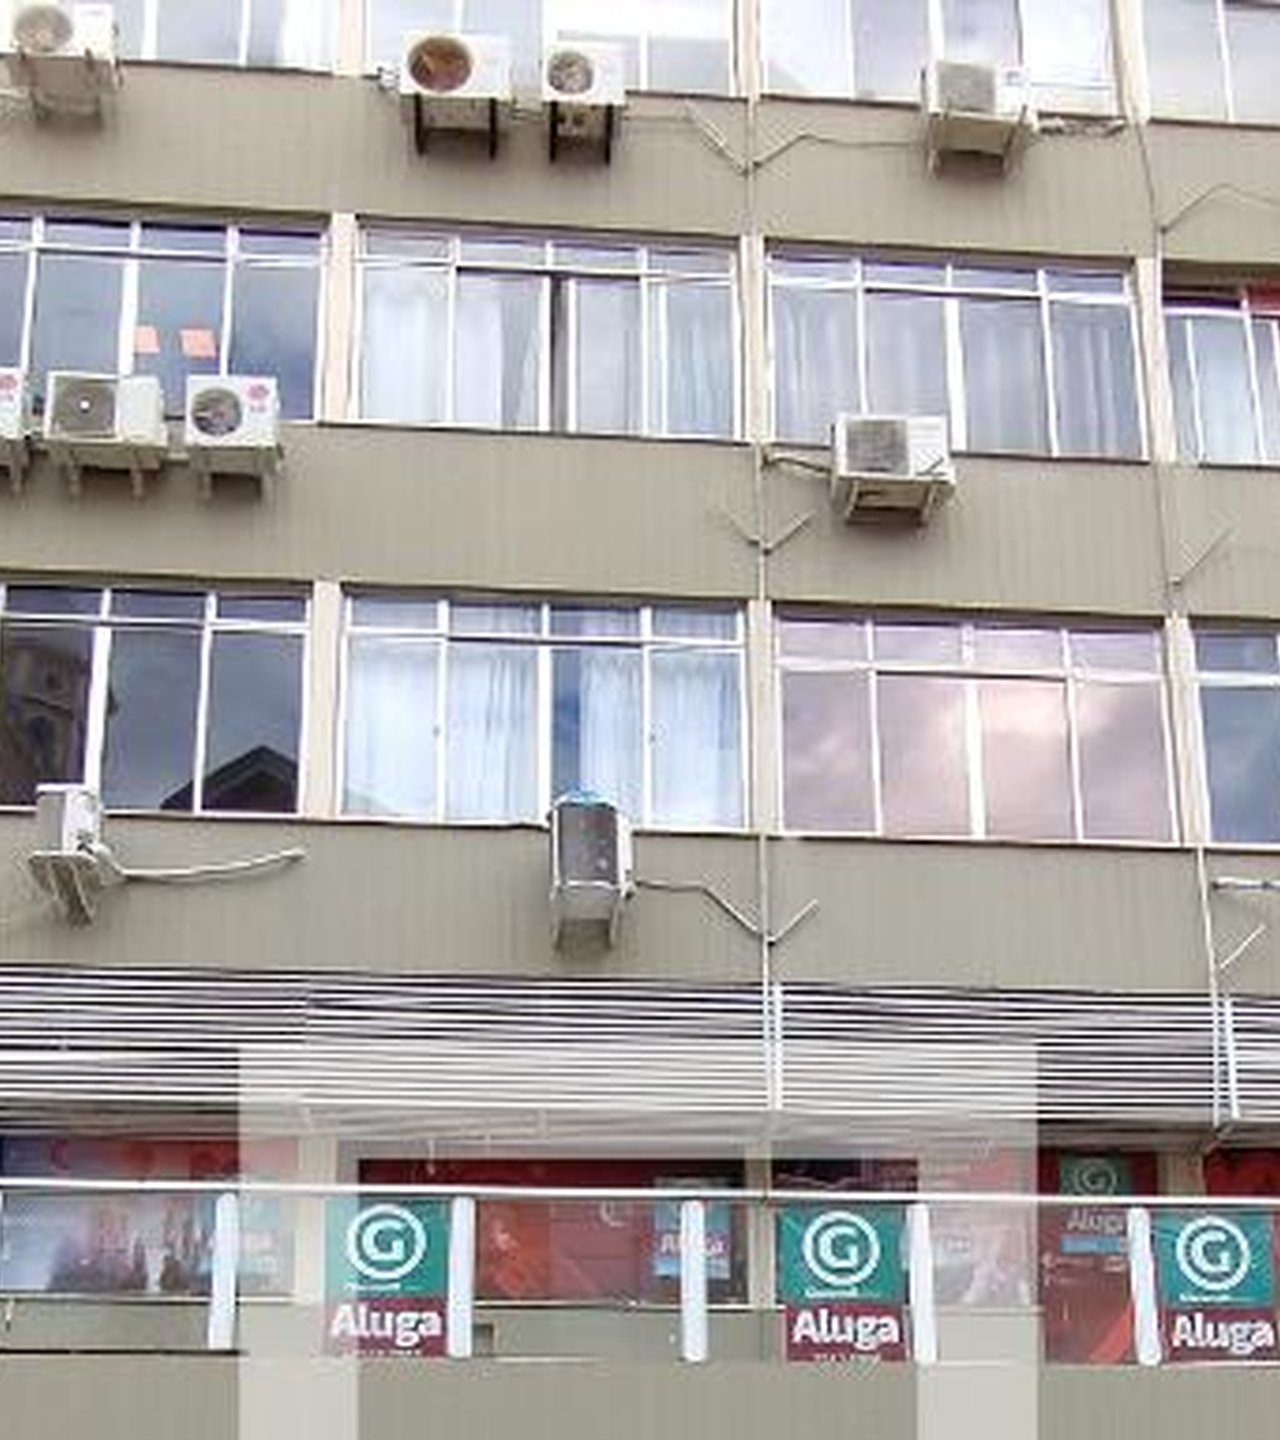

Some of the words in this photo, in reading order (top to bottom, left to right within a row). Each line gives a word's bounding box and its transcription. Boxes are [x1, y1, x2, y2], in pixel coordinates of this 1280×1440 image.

[330, 1303, 442, 1347] Aluga
[792, 1307, 900, 1351] Aluga
[1171, 1312, 1276, 1355] Aluga
